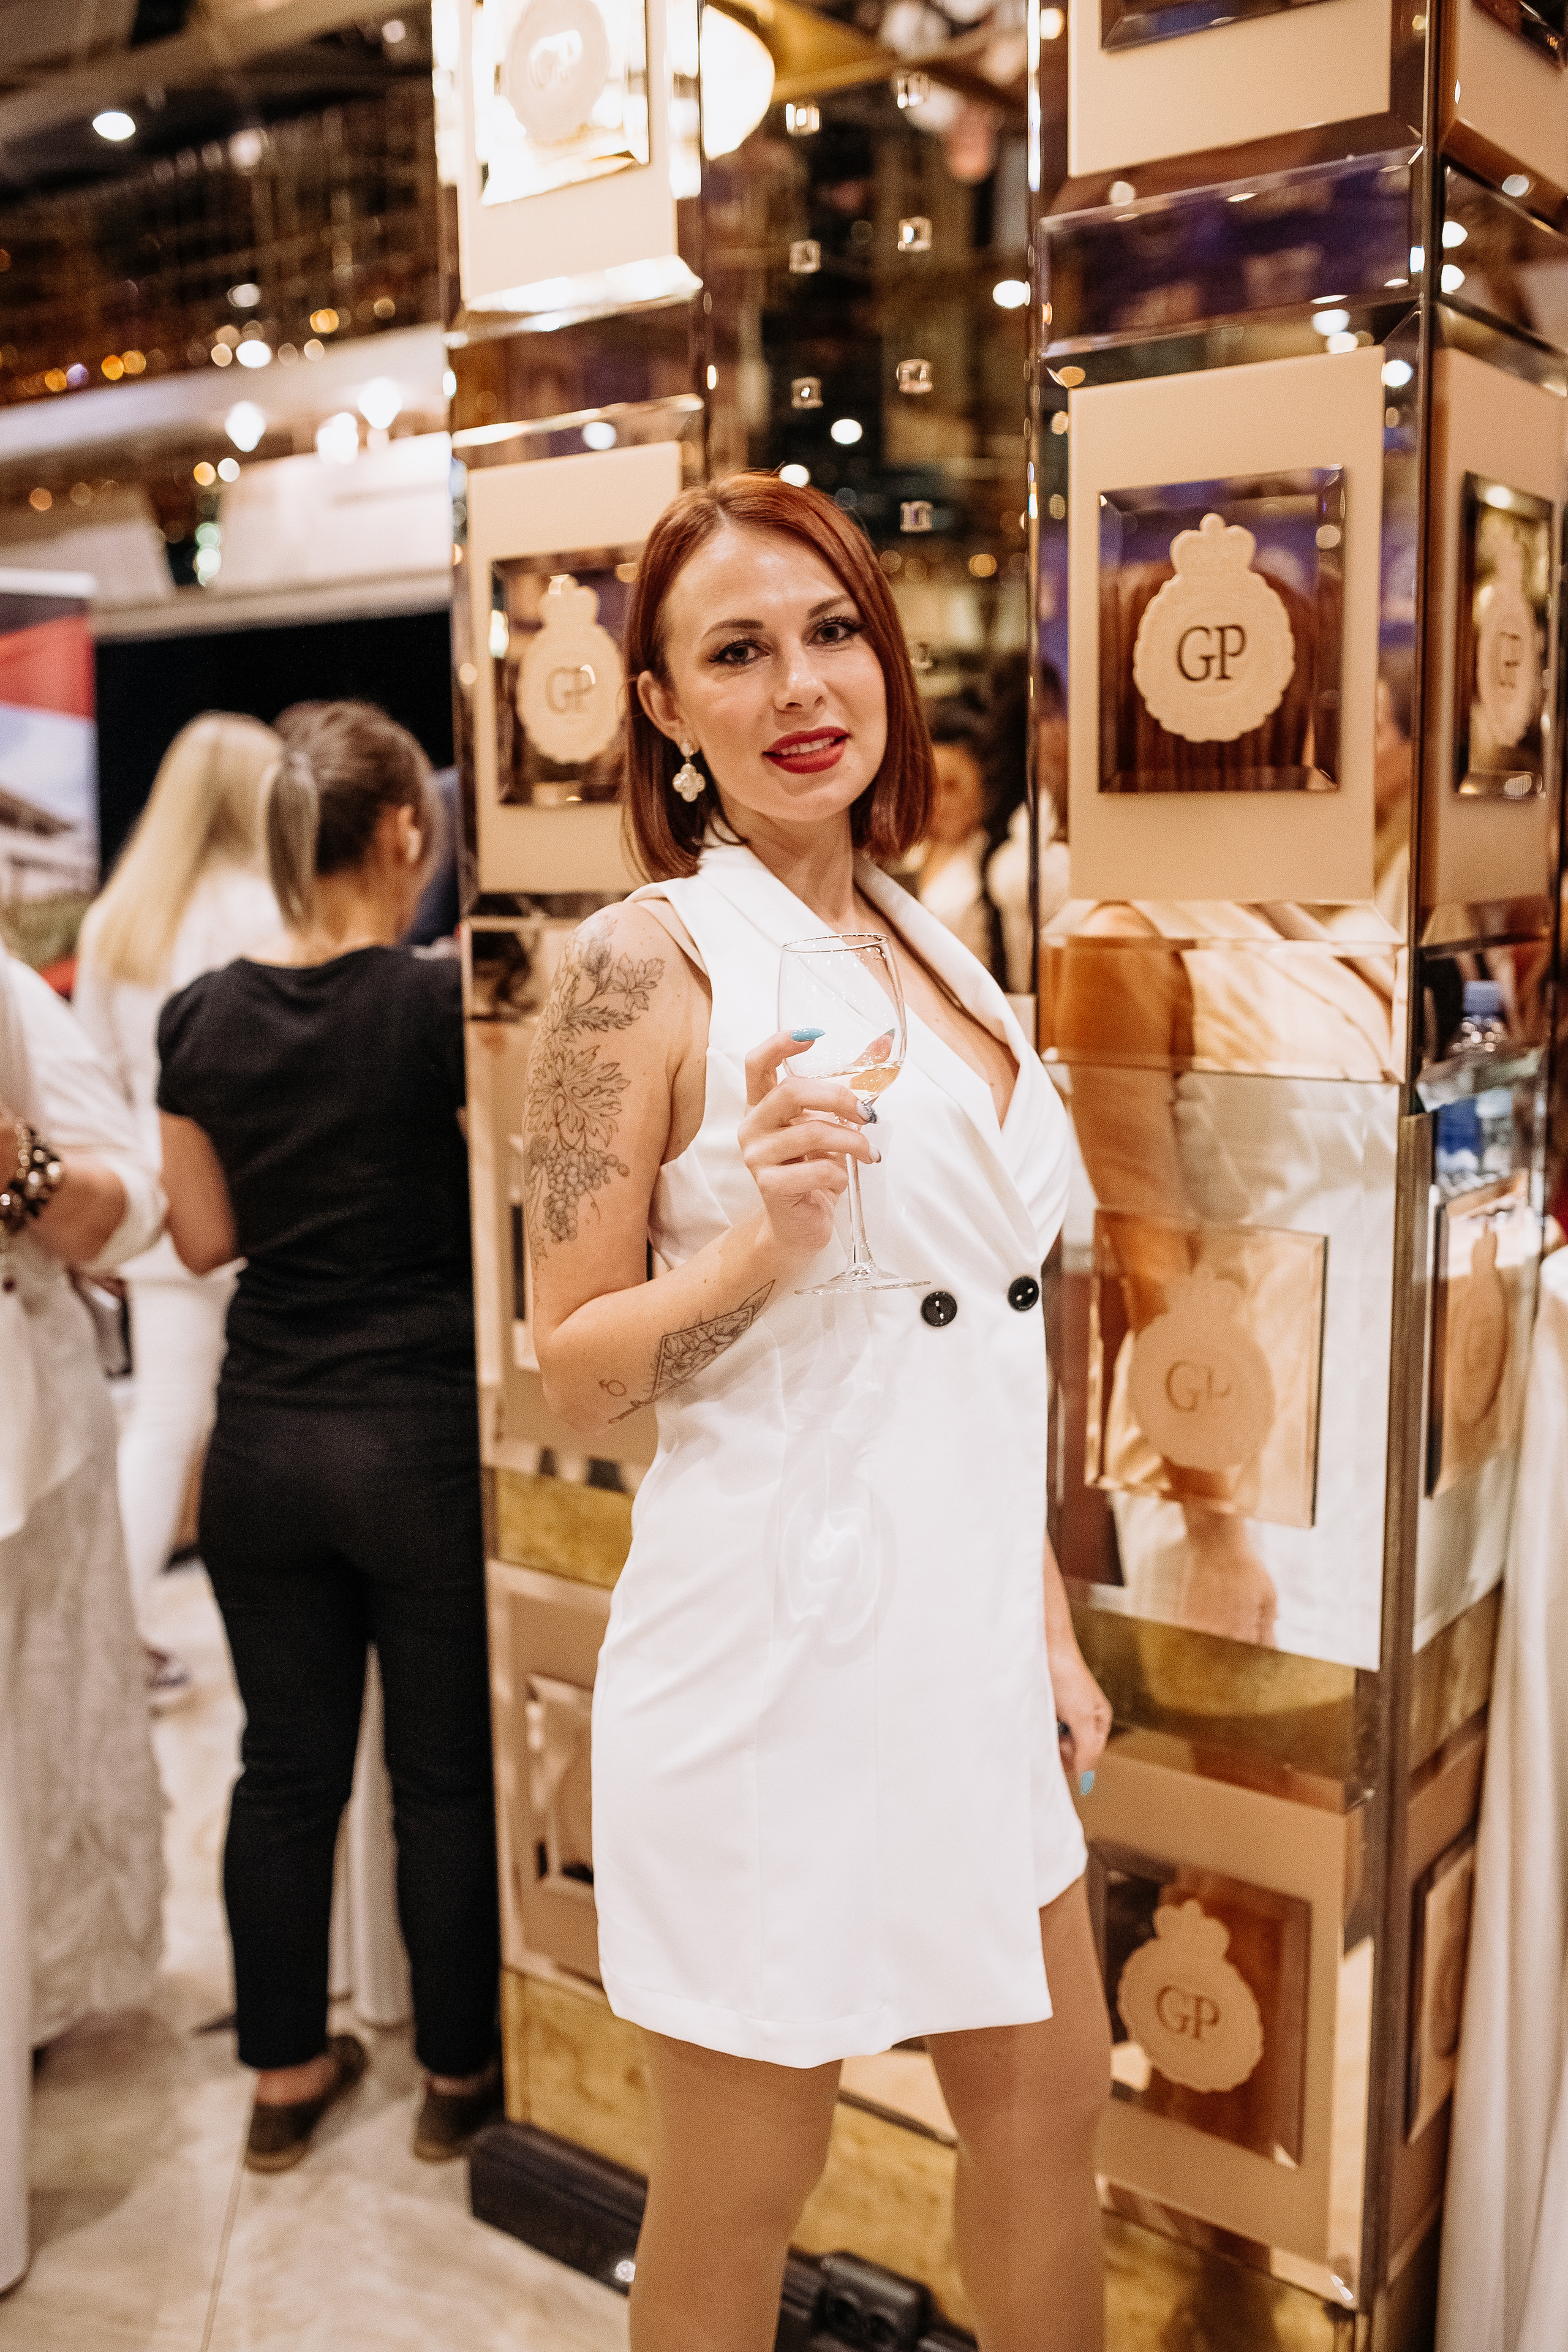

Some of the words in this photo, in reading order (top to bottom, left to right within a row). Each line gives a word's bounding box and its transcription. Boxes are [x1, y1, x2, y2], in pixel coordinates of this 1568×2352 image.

[1176, 624, 1246, 682] GP
[545, 665, 596, 715] GP
[1155, 1985, 1220, 2041] GP
